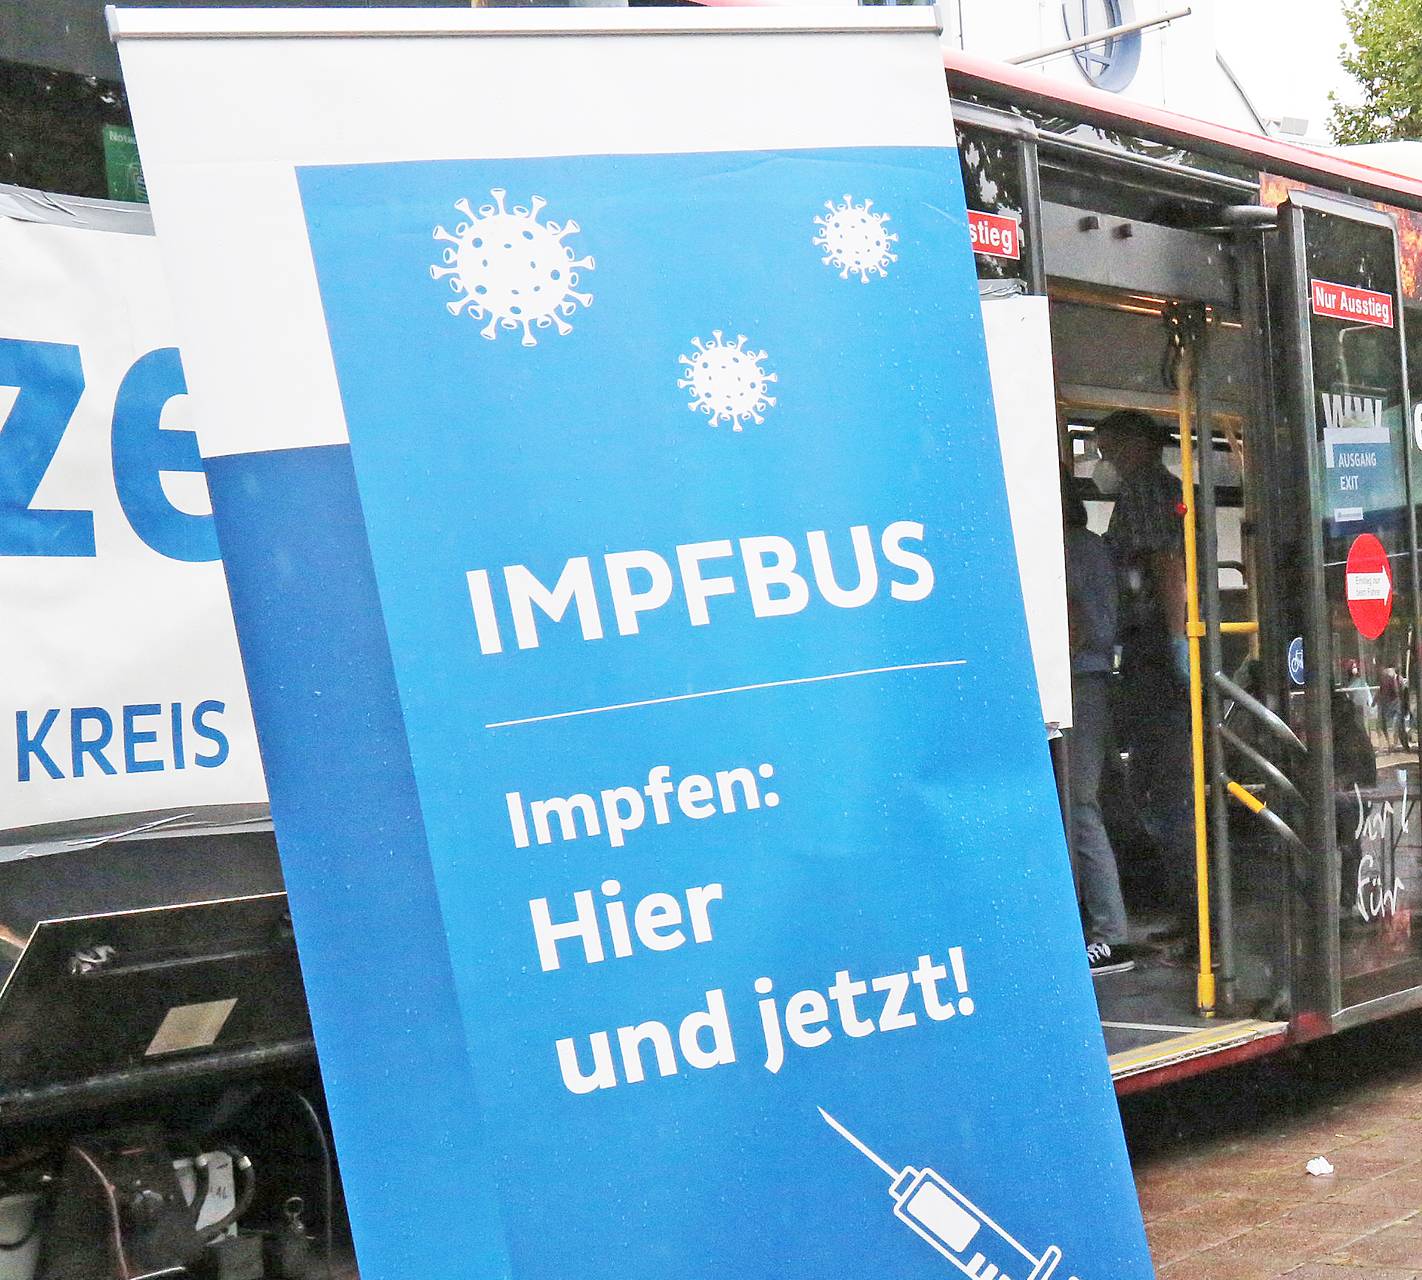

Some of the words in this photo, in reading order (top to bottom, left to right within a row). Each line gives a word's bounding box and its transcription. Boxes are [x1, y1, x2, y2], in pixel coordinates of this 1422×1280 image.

[1315, 286, 1336, 309] Nur
[1340, 291, 1389, 324] Ausstieg
[1338, 452, 1377, 468] AUSGANG
[1340, 475, 1359, 491] EXIT
[466, 520, 936, 655] IMPFBUS
[15, 698, 231, 783] KREIS
[505, 763, 781, 849] Impfen:
[529, 878, 723, 972] Hier
[555, 988, 737, 1094] und
[753, 946, 976, 1074] jetzt!
